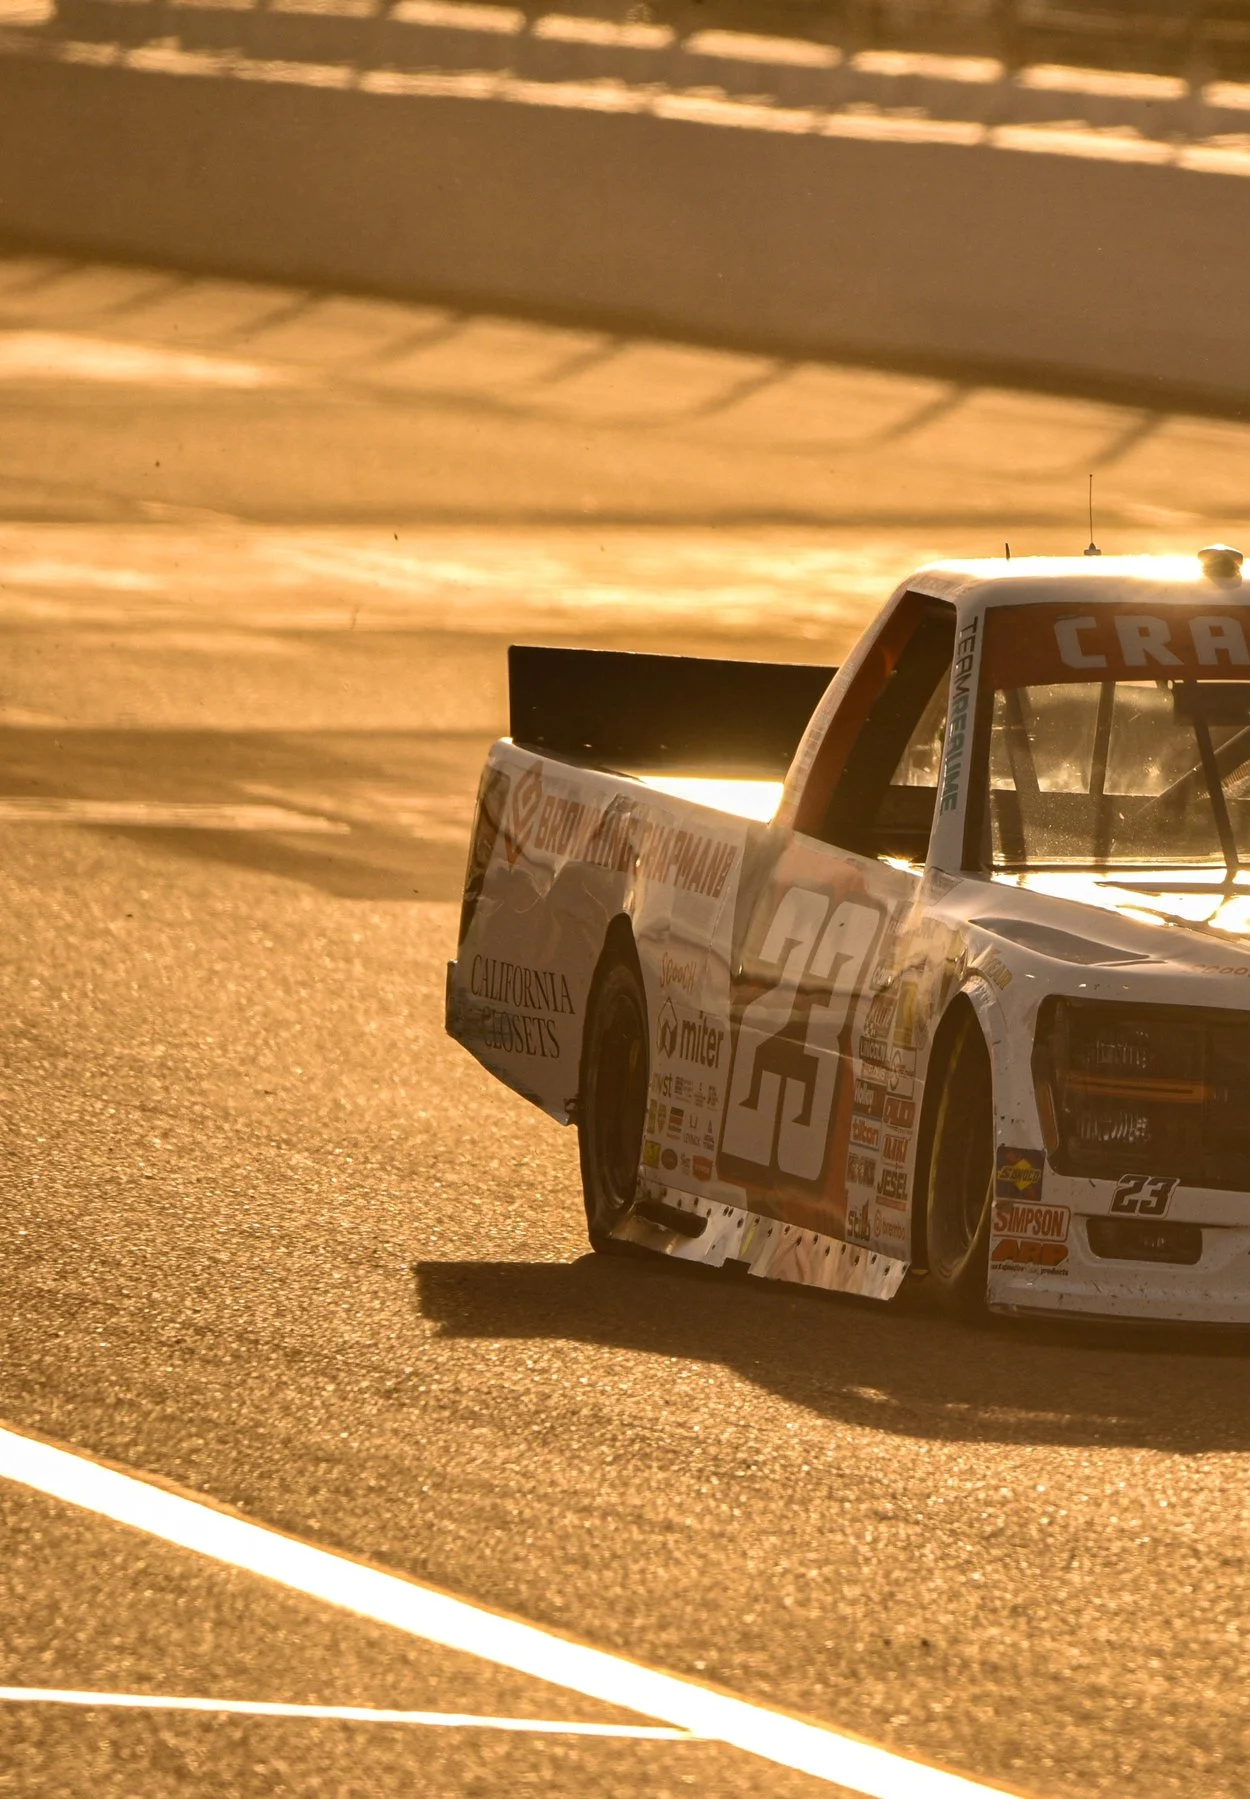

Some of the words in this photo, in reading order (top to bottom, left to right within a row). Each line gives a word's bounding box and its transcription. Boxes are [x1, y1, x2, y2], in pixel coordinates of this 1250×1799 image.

[471, 953, 576, 1015] CALIFORNIA
[679, 1010, 725, 1069] miter
[722, 886, 883, 1182] 23
[877, 1169, 908, 1200] JESEL
[1110, 1174, 1180, 1218] 23
[993, 1205, 1065, 1238] SIMPSON
[991, 1238, 1069, 1267] ARP
